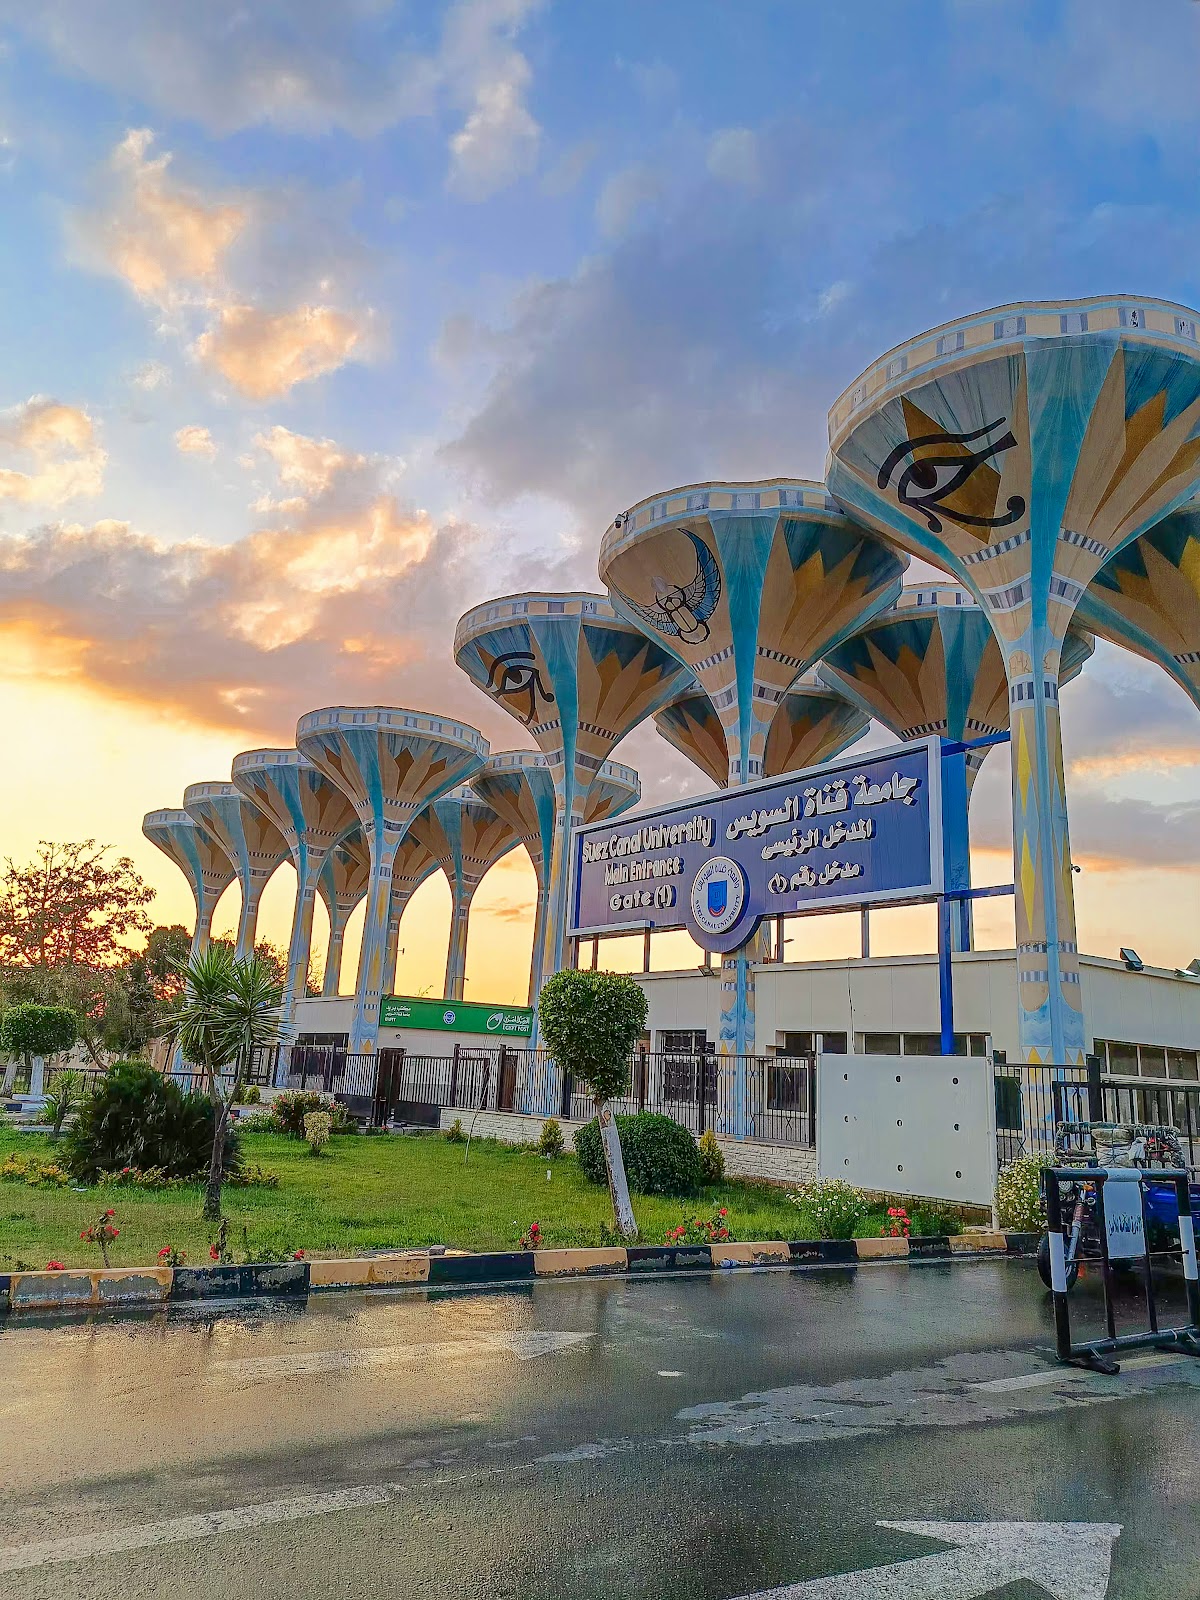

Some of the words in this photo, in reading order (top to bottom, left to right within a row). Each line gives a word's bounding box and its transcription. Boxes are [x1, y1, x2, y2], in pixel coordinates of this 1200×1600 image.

[804, 779, 848, 817] قناة
[853, 771, 918, 806] جامعة
[726, 795, 799, 840] السويس
[582, 840, 610, 864] Suez
[609, 829, 642, 858] Canal
[643, 815, 713, 848] University
[822, 818, 873, 849] المدخل
[604, 861, 629, 886] Main
[629, 856, 682, 882] Entrance
[790, 865, 816, 891] رقم
[819, 860, 861, 885] مدخل
[610, 889, 651, 911] Gate
[654, 884, 675, 909] (1)
